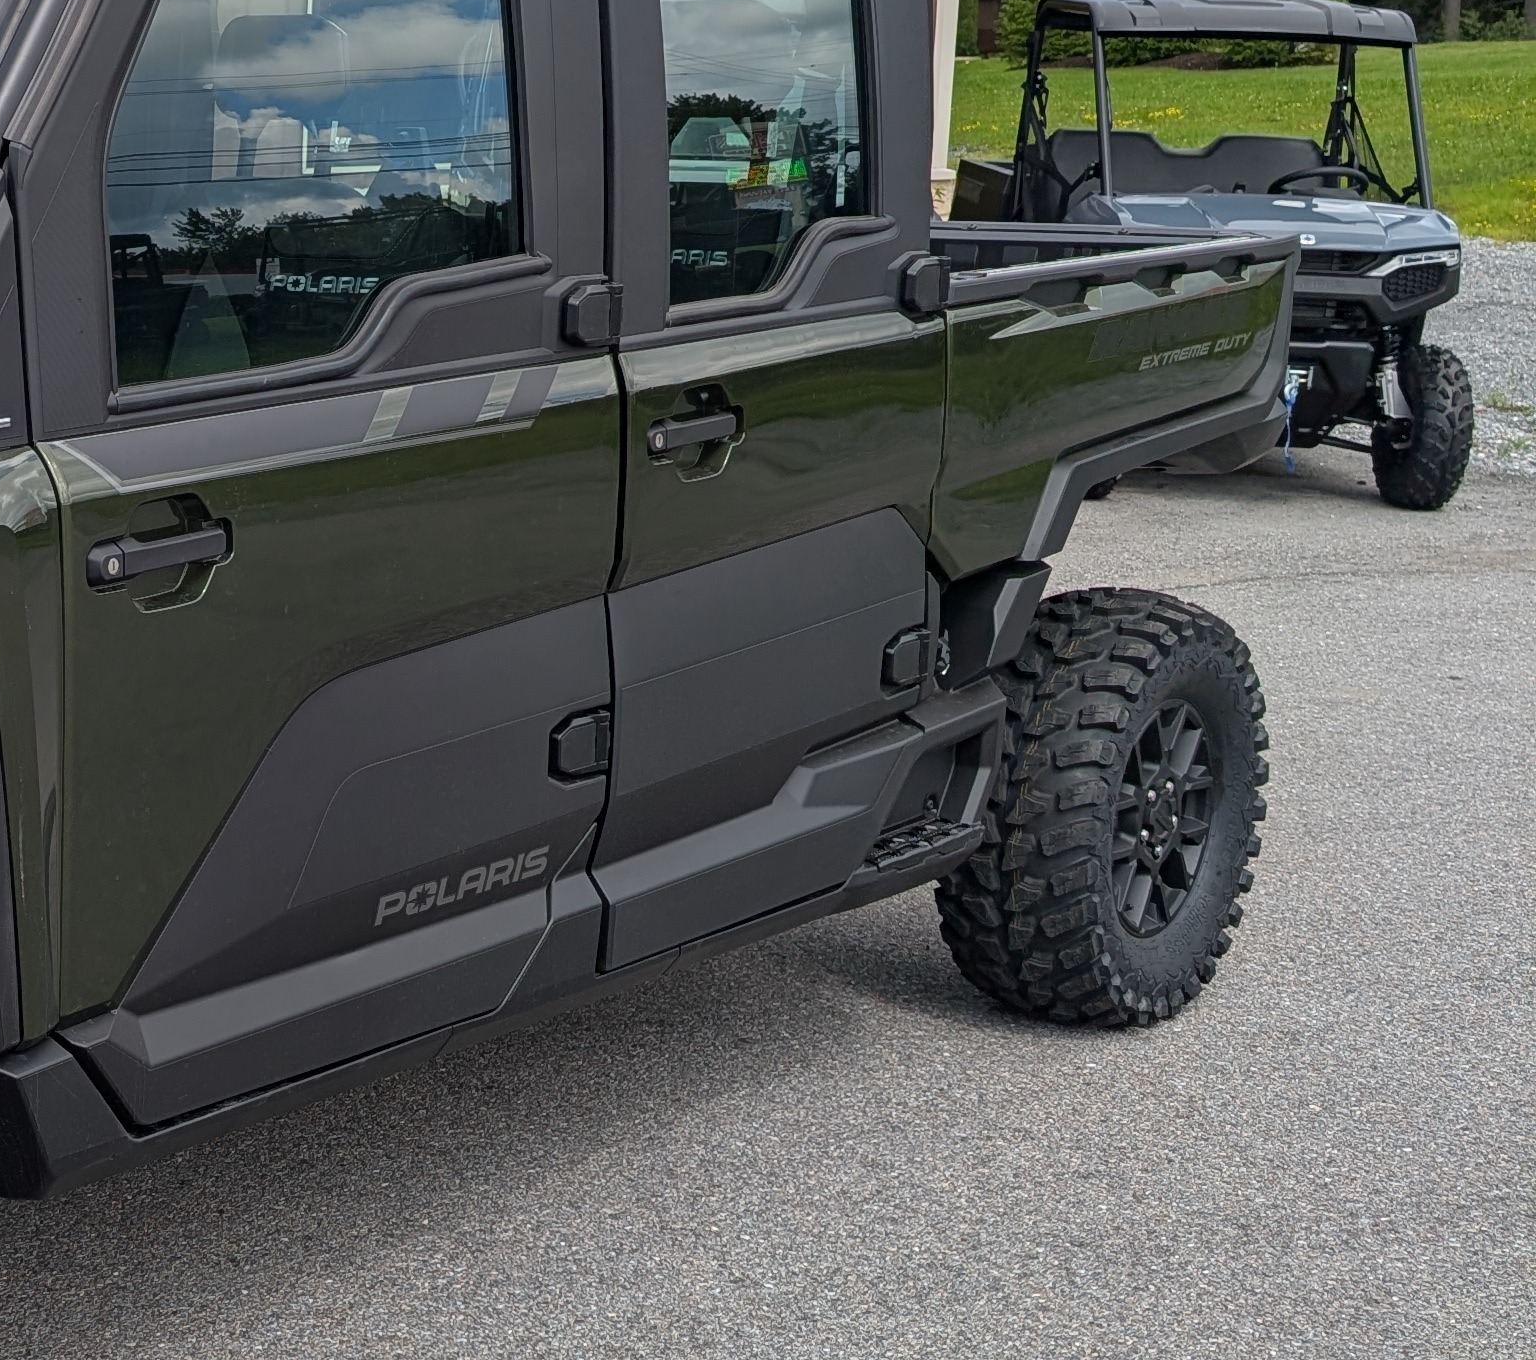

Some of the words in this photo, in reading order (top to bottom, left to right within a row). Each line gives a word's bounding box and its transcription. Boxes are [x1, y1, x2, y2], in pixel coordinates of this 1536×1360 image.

[671, 248, 728, 267] ARIS
[269, 274, 380, 294] POLARIS
[1139, 342, 1212, 371] EXTREME
[1214, 331, 1252, 353] DUTY
[374, 845, 550, 927] POLARIS
